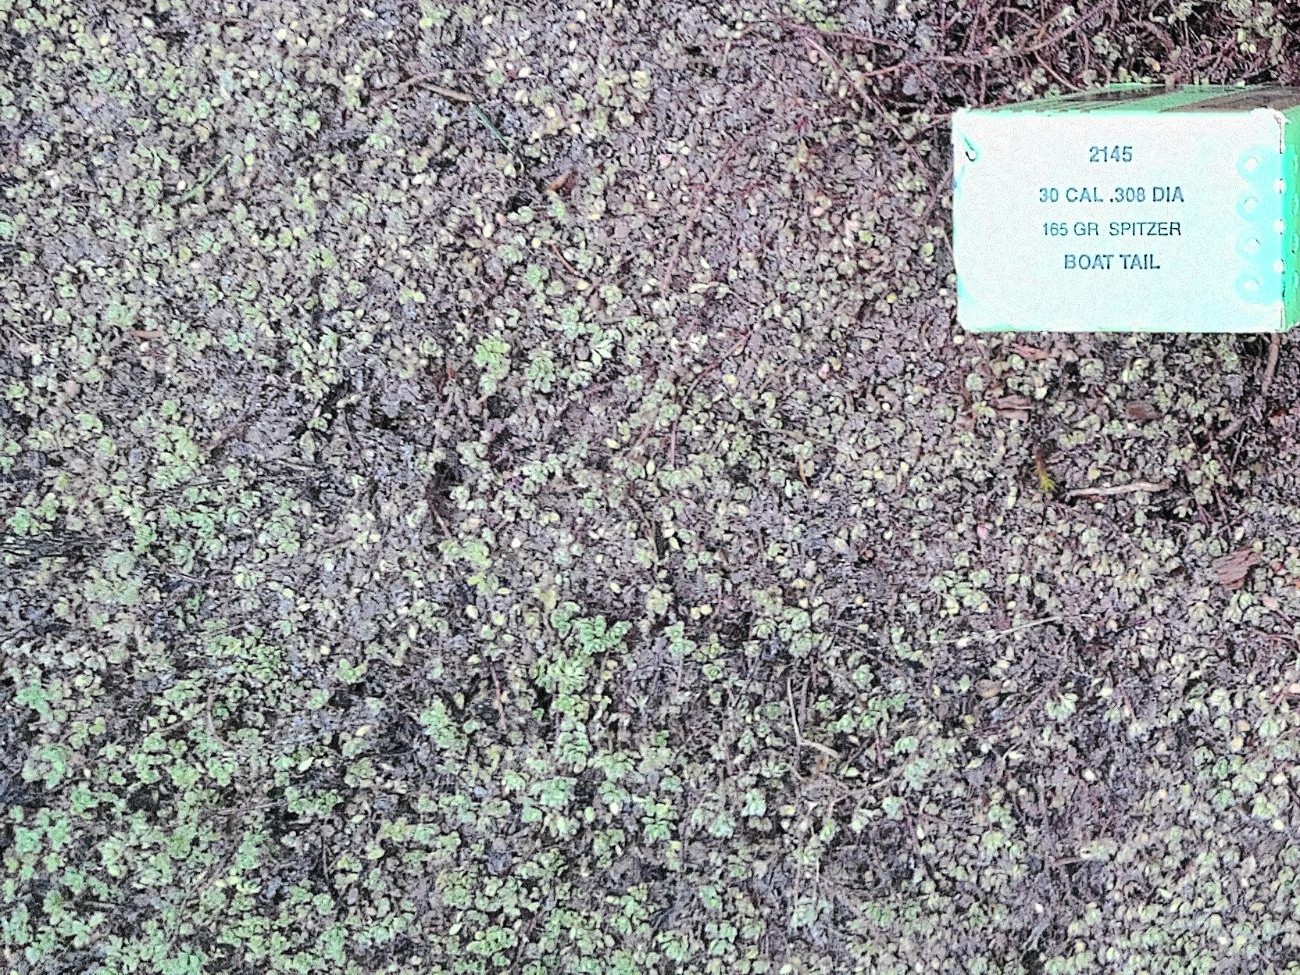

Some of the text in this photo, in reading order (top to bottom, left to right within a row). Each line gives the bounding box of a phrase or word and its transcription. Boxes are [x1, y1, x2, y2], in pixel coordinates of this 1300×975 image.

[1089, 146, 1133, 163] 2145
[1039, 187, 1184, 203] 30 CAL .308 DIA
[1043, 222, 1181, 236] 165 GR SPITZER
[1064, 254, 1160, 270] BOAT TAIL
